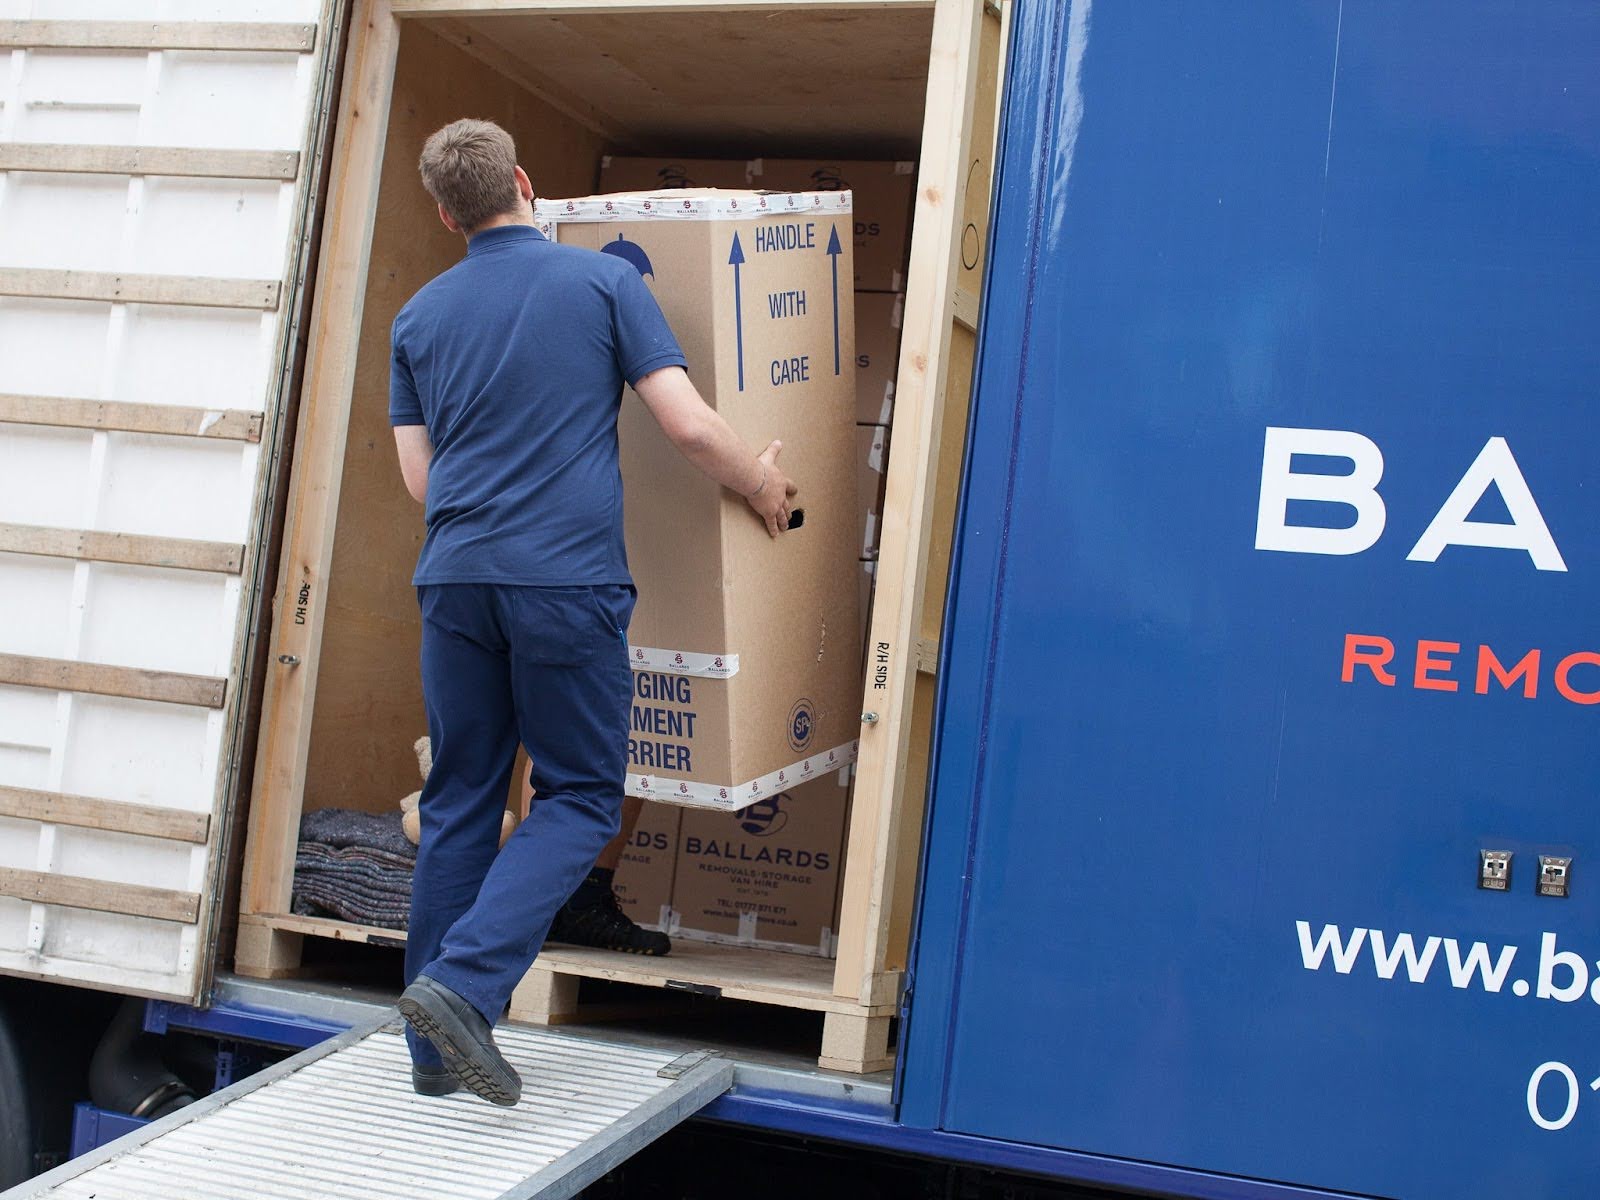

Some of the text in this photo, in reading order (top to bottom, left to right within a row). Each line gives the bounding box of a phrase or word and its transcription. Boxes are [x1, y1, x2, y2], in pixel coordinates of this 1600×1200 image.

[756, 223, 815, 253] HANDLE
[768, 290, 806, 319] WITH
[771, 356, 809, 386] CARE
[1255, 426, 1568, 571] BA
[295, 582, 311, 625] L/H SIDE
[874, 642, 890, 690] R/H SIDE
[1341, 633, 1600, 705] REMO
[633, 671, 691, 704] GING
[629, 705, 696, 738] MENT
[627, 738, 692, 772] RRIER
[686, 837, 830, 870] BALLARDS
[730, 875, 779, 888] VAN HIRE
[1296, 920, 1600, 1006] www.b
